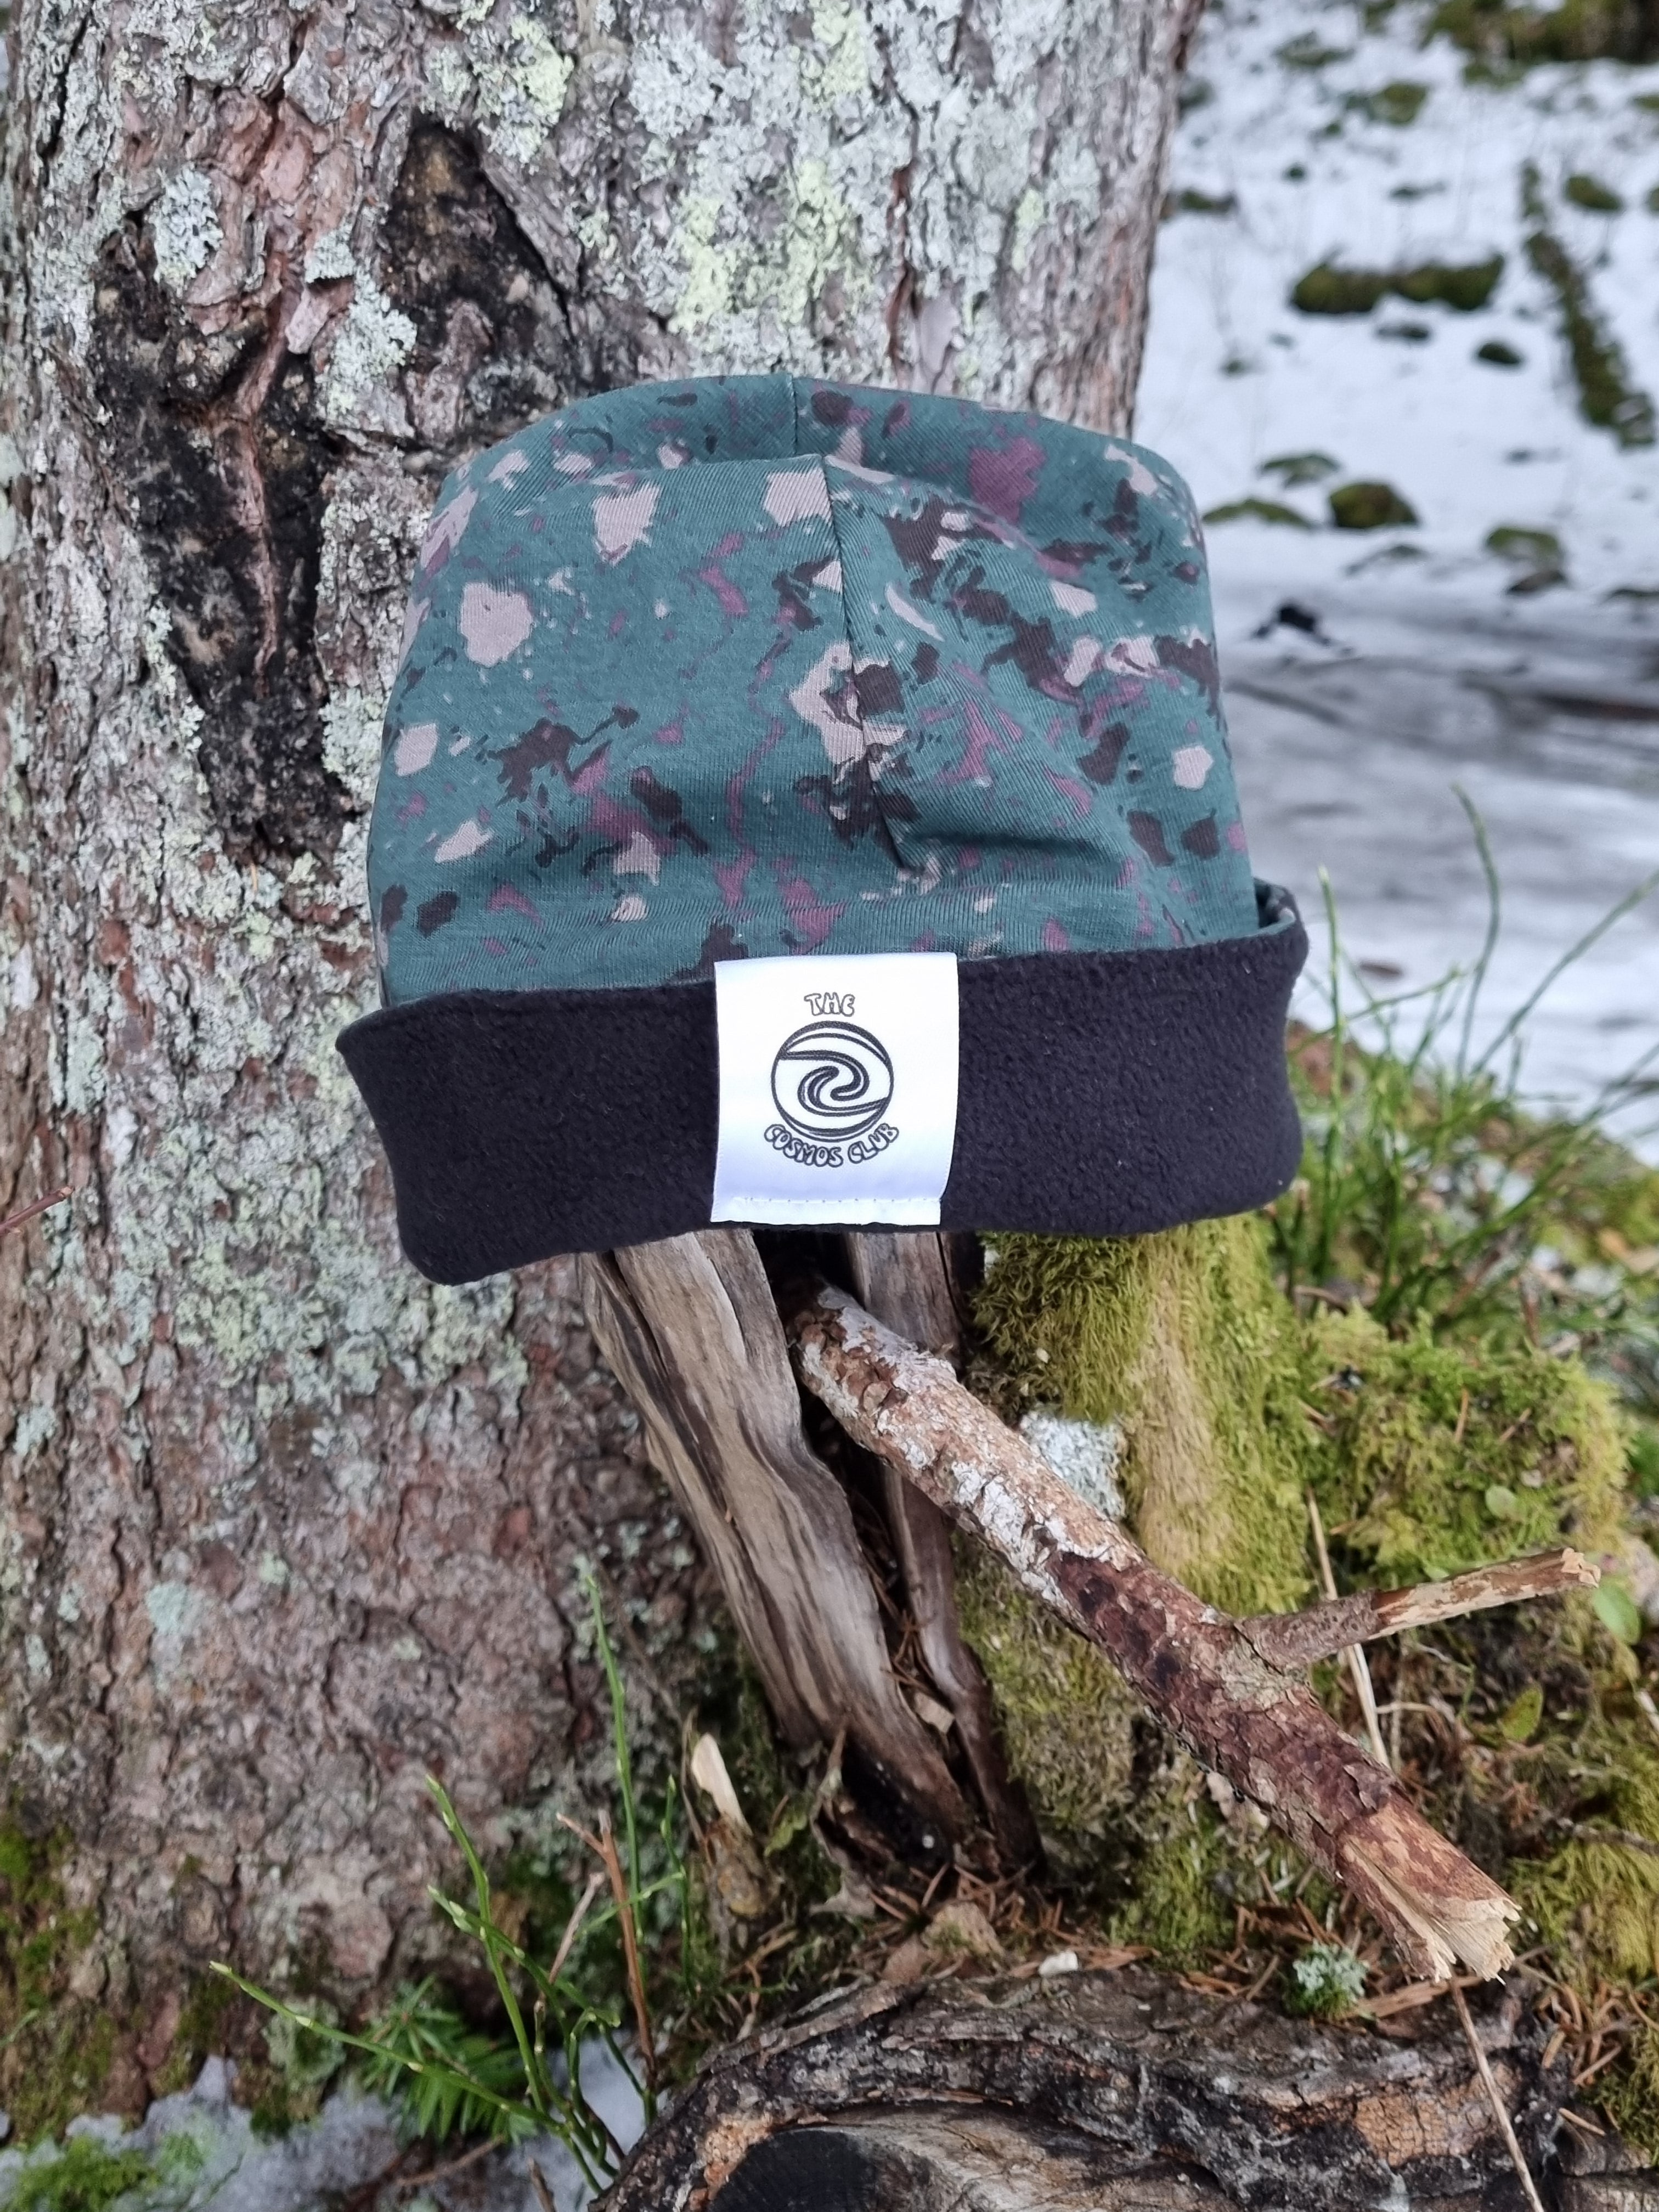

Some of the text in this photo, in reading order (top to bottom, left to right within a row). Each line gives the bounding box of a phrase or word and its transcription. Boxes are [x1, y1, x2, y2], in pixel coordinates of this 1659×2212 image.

[804, 992, 855, 1017] THE
[764, 1122, 899, 1167] COSMOS CLUB
